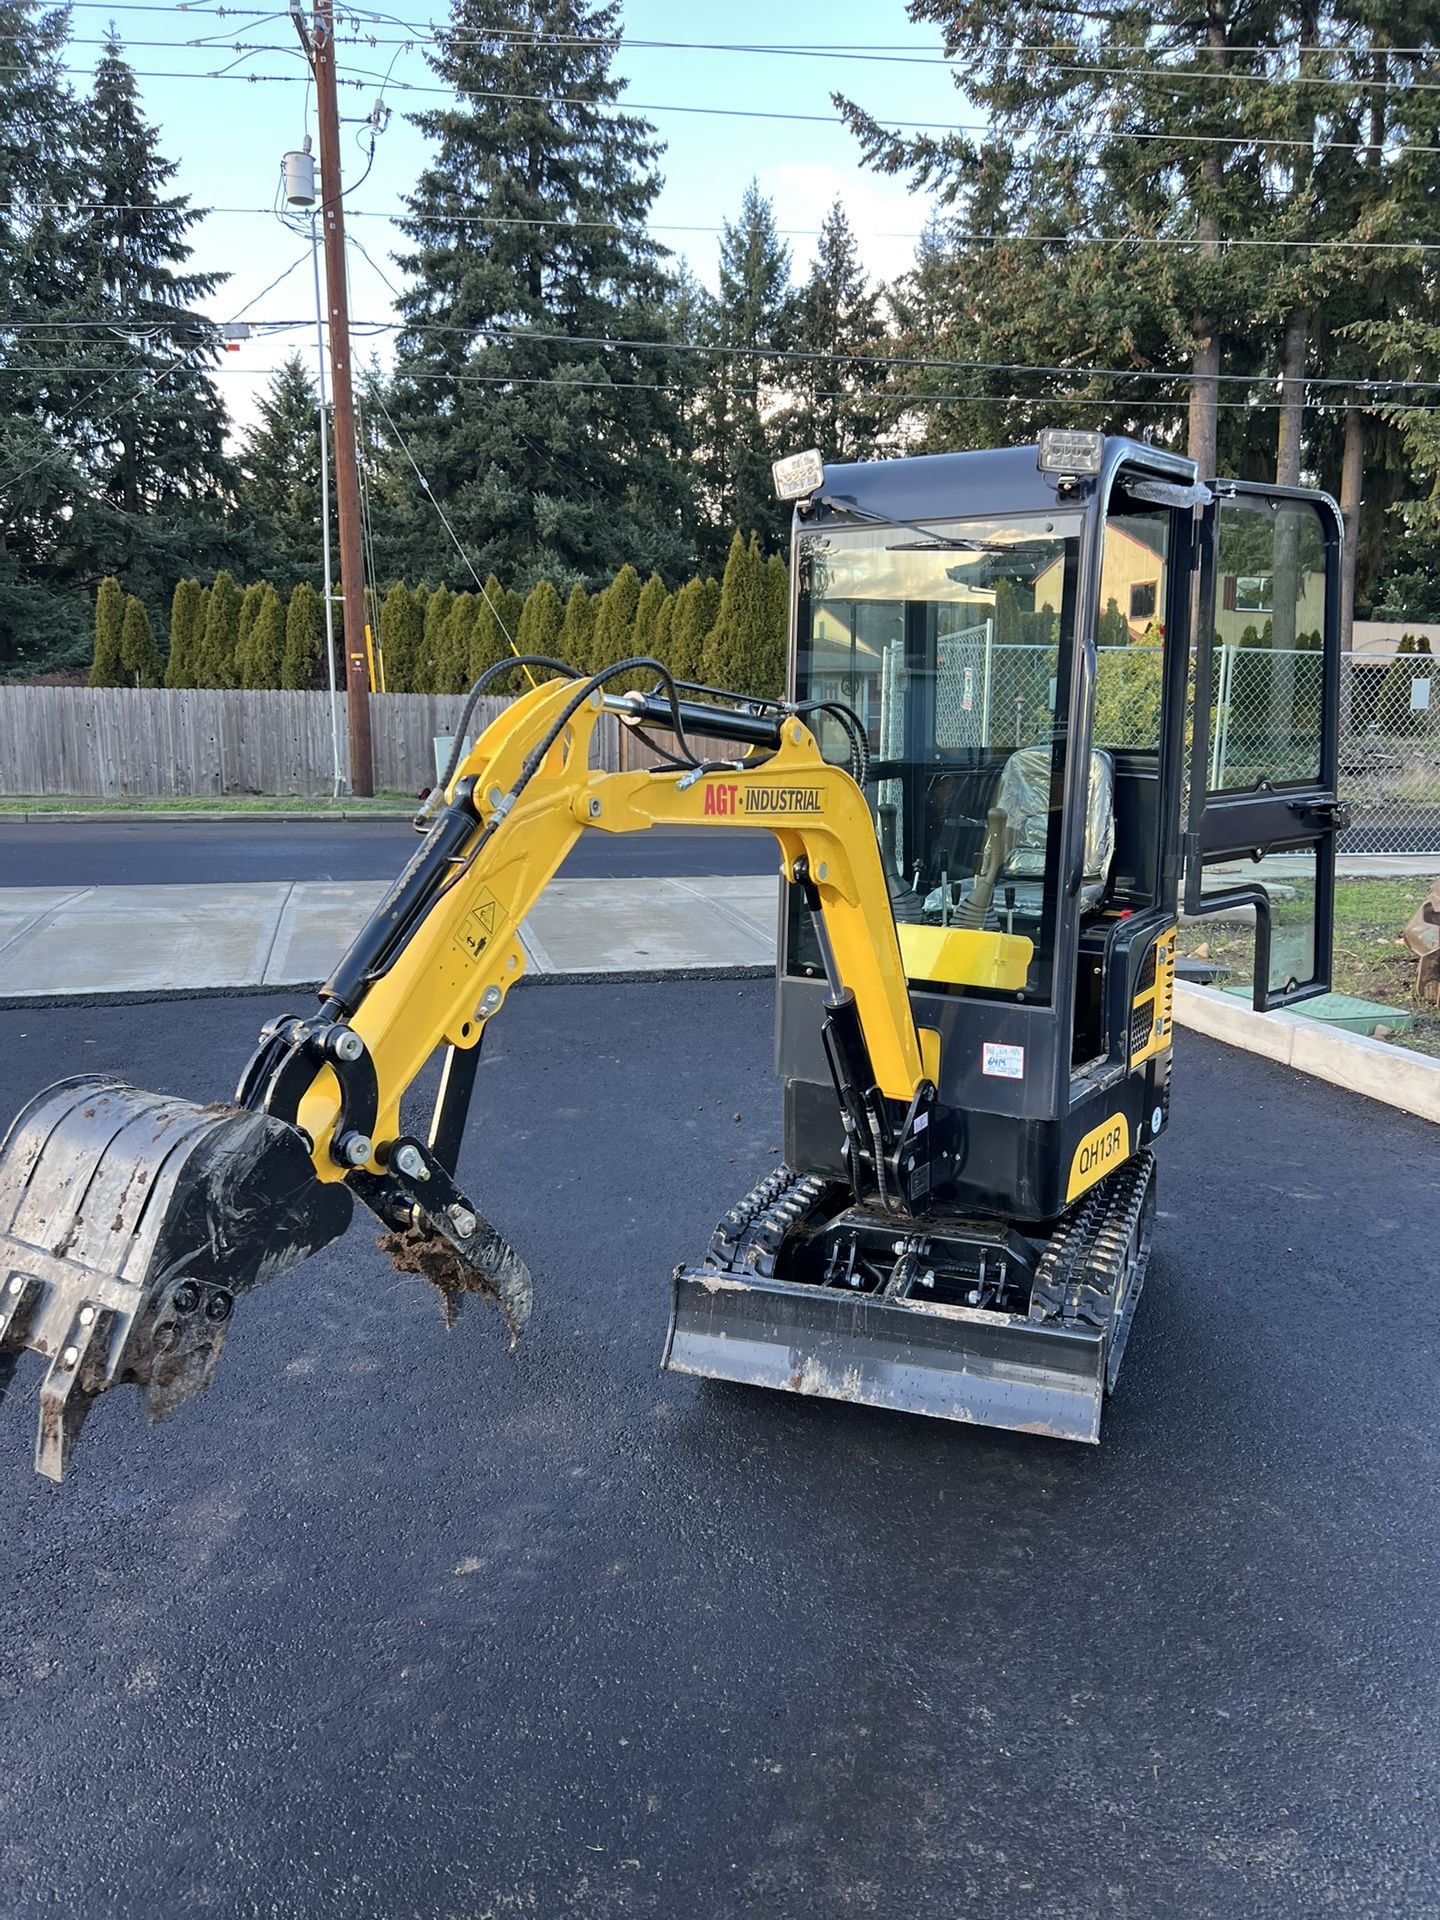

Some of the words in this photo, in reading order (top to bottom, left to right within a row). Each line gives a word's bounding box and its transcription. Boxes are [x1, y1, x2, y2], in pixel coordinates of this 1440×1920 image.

[704, 784, 738, 815] AGT
[746, 789, 821, 811] INDUSTRIAL
[1079, 1126, 1121, 1174] QH13R
